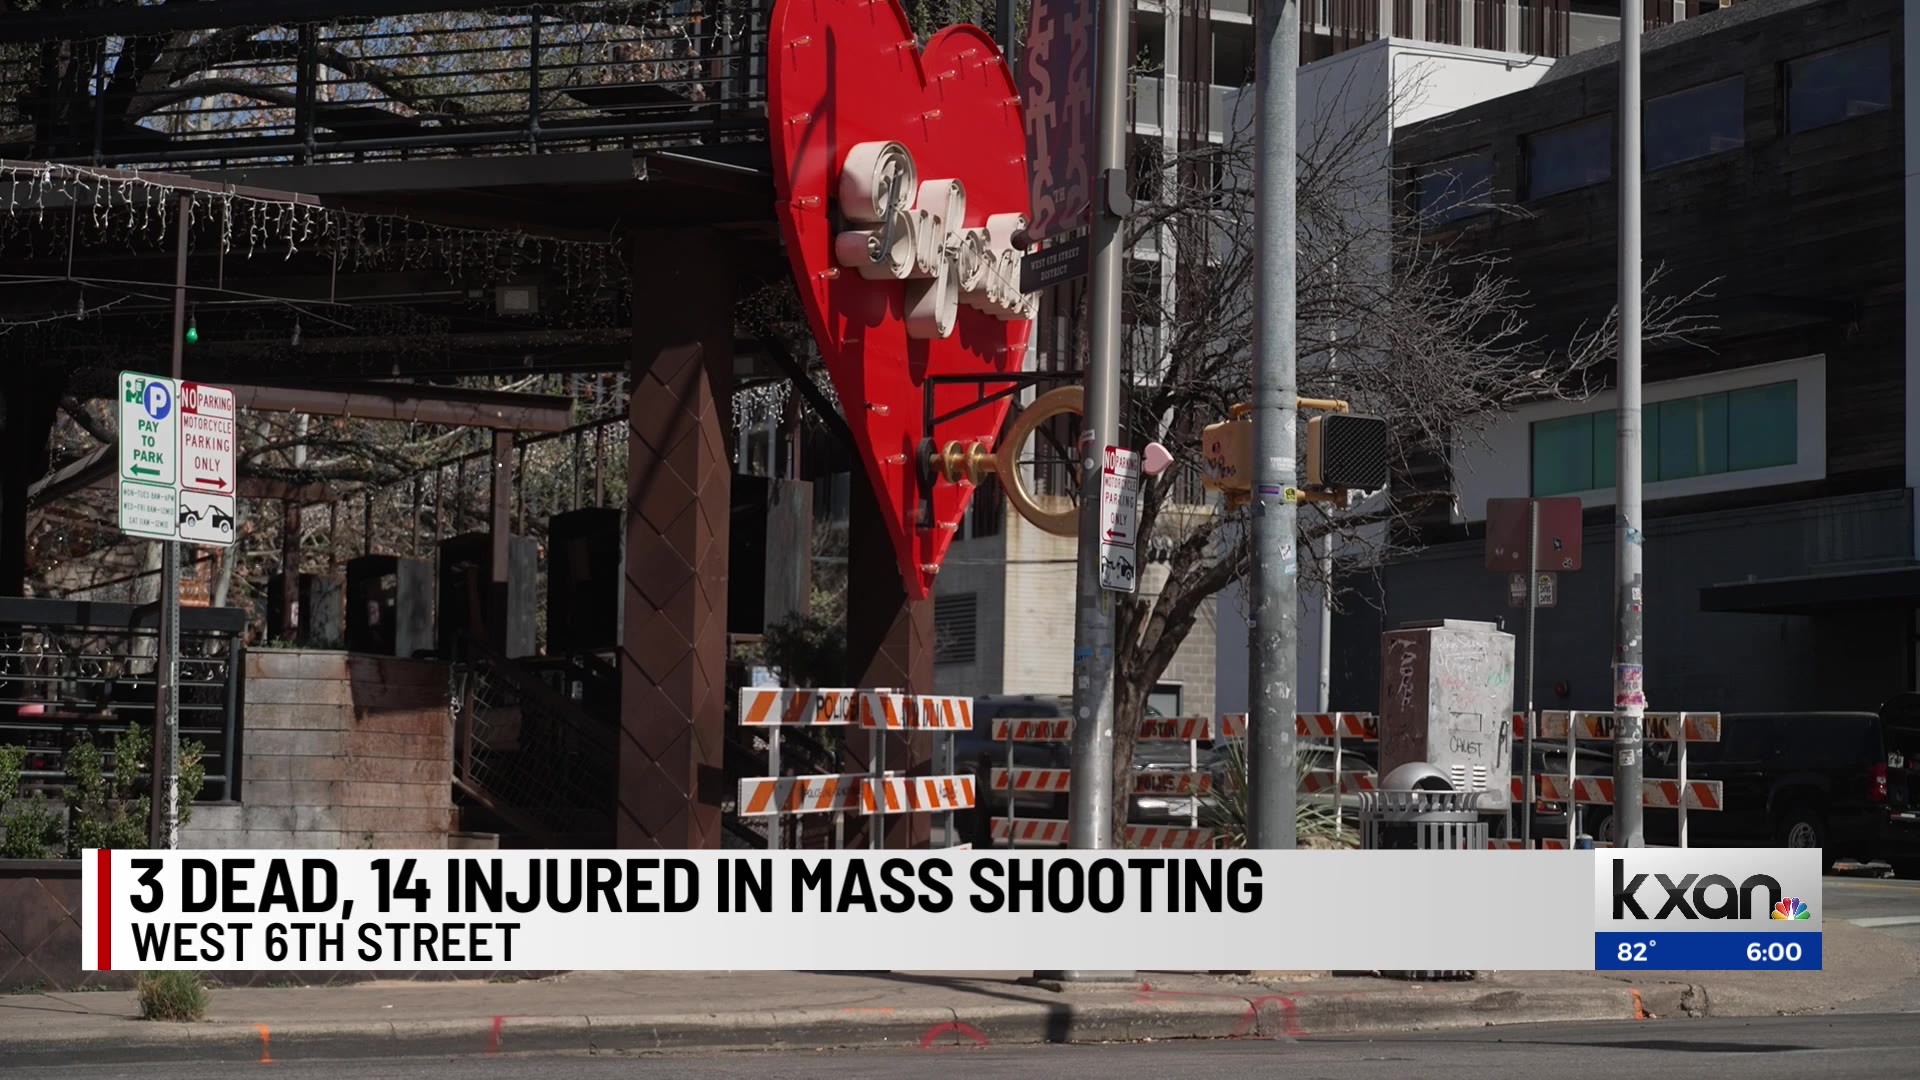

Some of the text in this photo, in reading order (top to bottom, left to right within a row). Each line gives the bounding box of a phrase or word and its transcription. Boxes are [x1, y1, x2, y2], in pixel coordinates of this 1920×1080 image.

[1030, 257, 1046, 270] WEST
[1058, 247, 1080, 263] STREET
[1040, 264, 1068, 281] DISTRICT
[150, 385, 167, 416] P
[181, 387, 232, 412] NO PARKING
[138, 419, 159, 433] PAY
[183, 416, 232, 435] MOTORCYCLE
[141, 435, 156, 448] TO
[185, 433, 230, 452] PARKING
[133, 449, 164, 465] PARK
[194, 456, 221, 472] ONLY
[1103, 451, 1138, 472] NO PARKING
[1104, 477, 1136, 492] MOTORCYCLE
[1105, 492, 1134, 508] PARKING
[1110, 512, 1128, 526] ONLY
[1594, 716, 1671, 739] AP TAC
